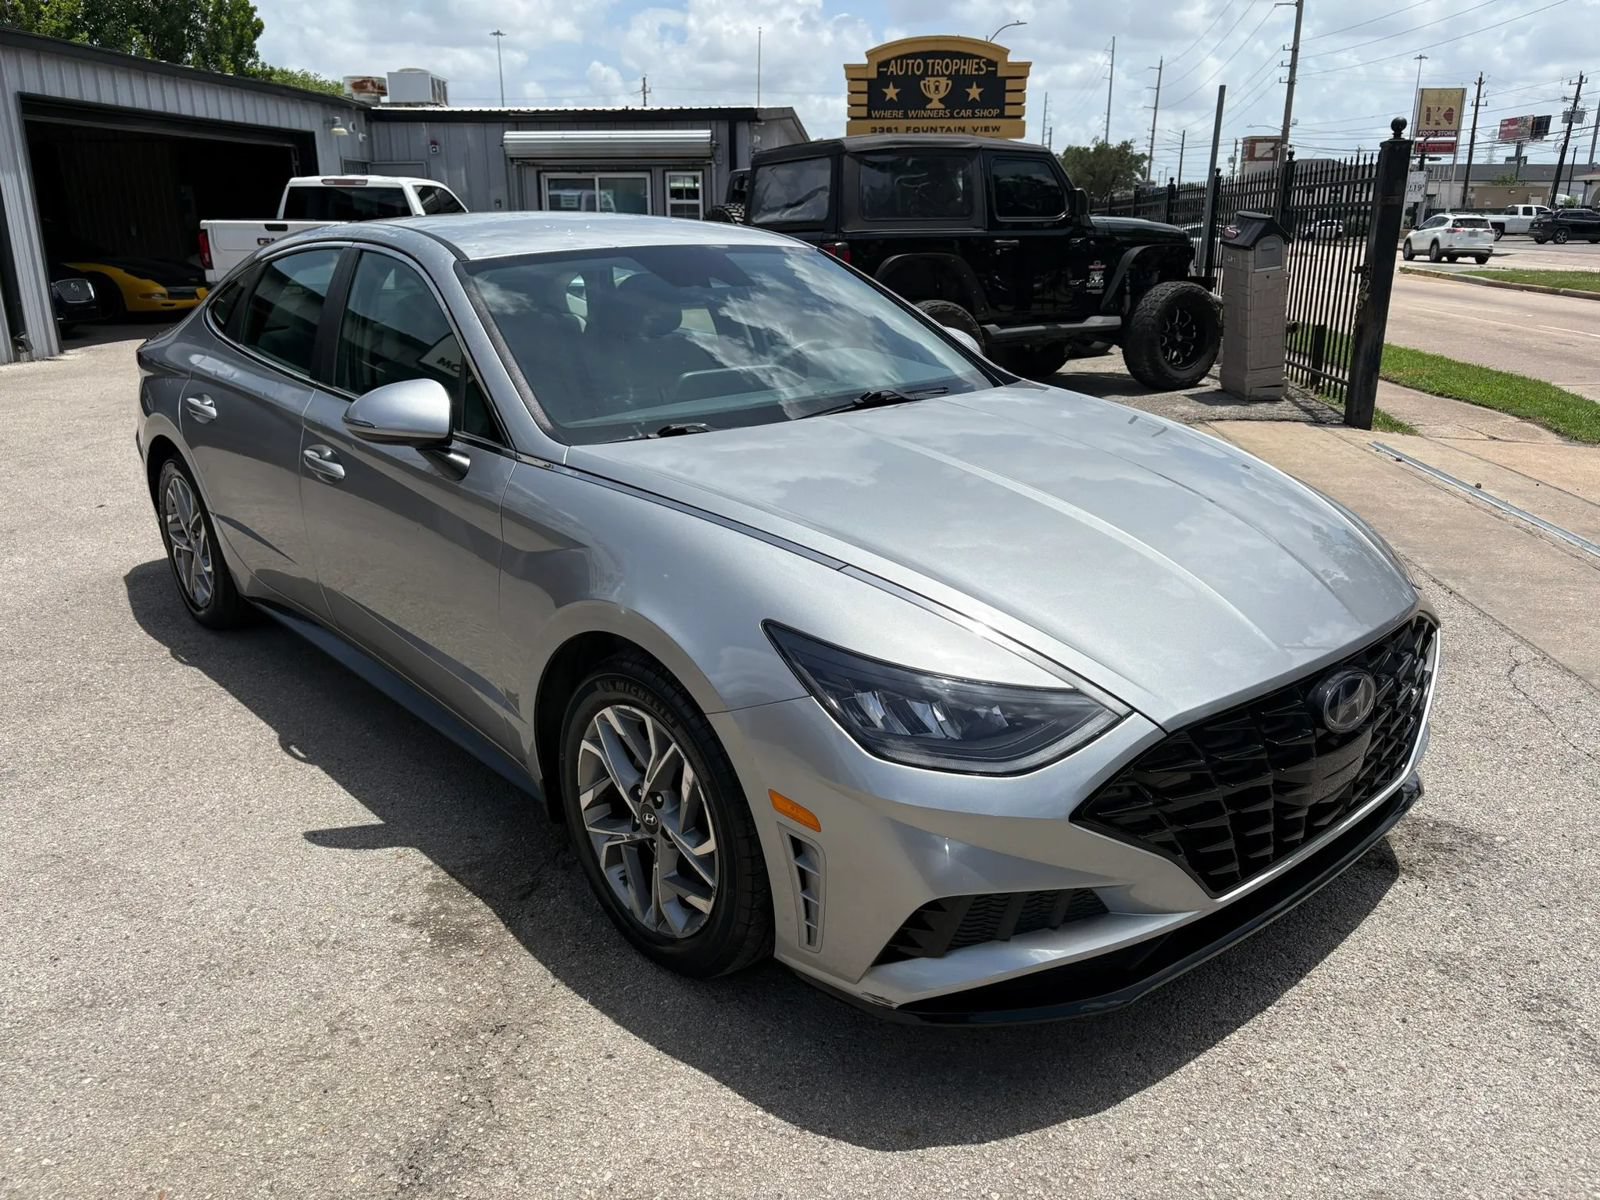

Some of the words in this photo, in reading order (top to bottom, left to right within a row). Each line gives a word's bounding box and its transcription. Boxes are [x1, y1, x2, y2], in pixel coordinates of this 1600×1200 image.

[887, 58, 924, 76] AUTO
[927, 58, 987, 76] TROPHIES
[871, 109, 905, 118] WHERE
[907, 109, 951, 118] WINNERS
[953, 109, 973, 118] CAR
[974, 108, 1000, 117] SHOP
[971, 125, 1001, 133] VIEW
[615, 680, 675, 724] MICHELIN
